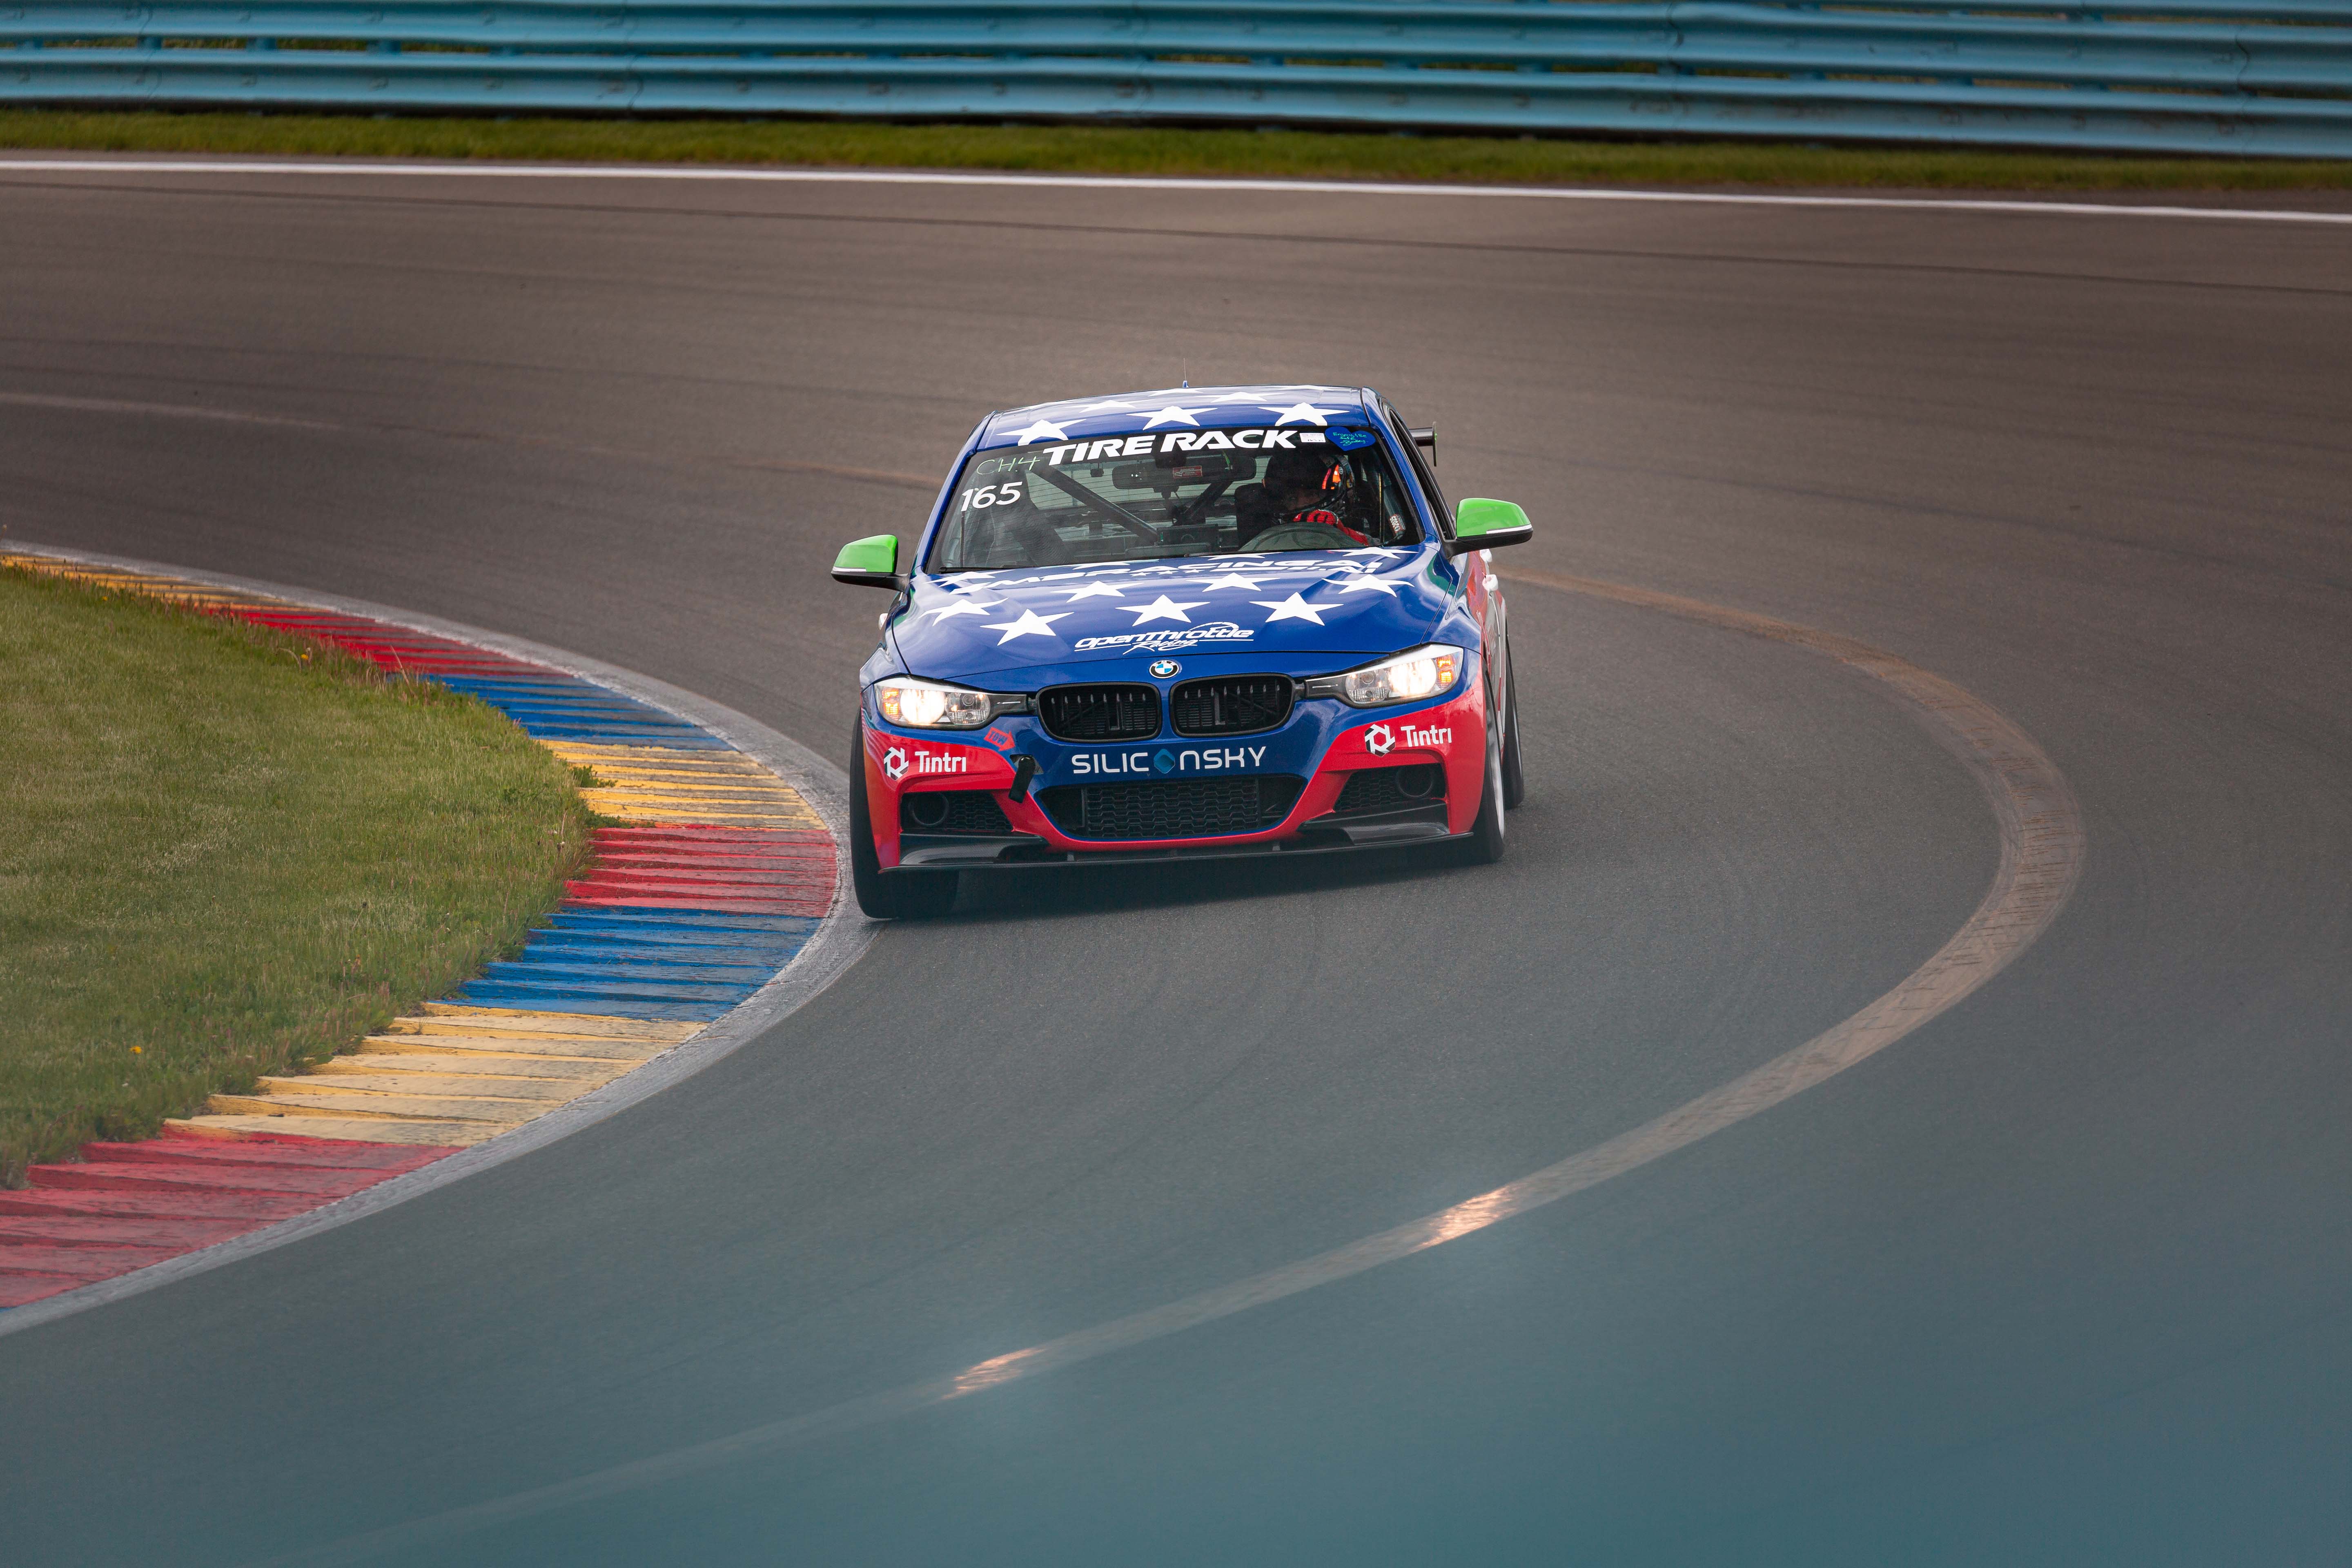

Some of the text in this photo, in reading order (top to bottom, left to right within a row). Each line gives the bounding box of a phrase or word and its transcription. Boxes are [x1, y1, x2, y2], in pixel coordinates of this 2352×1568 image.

[1043, 430, 1298, 466] TIRE RACK
[960, 481, 1023, 512] 165
[1123, 639, 1198, 655] Racing
[989, 730, 1008, 746] TOW
[1400, 725, 1452, 747] Tintri
[914, 751, 967, 773] Tintri
